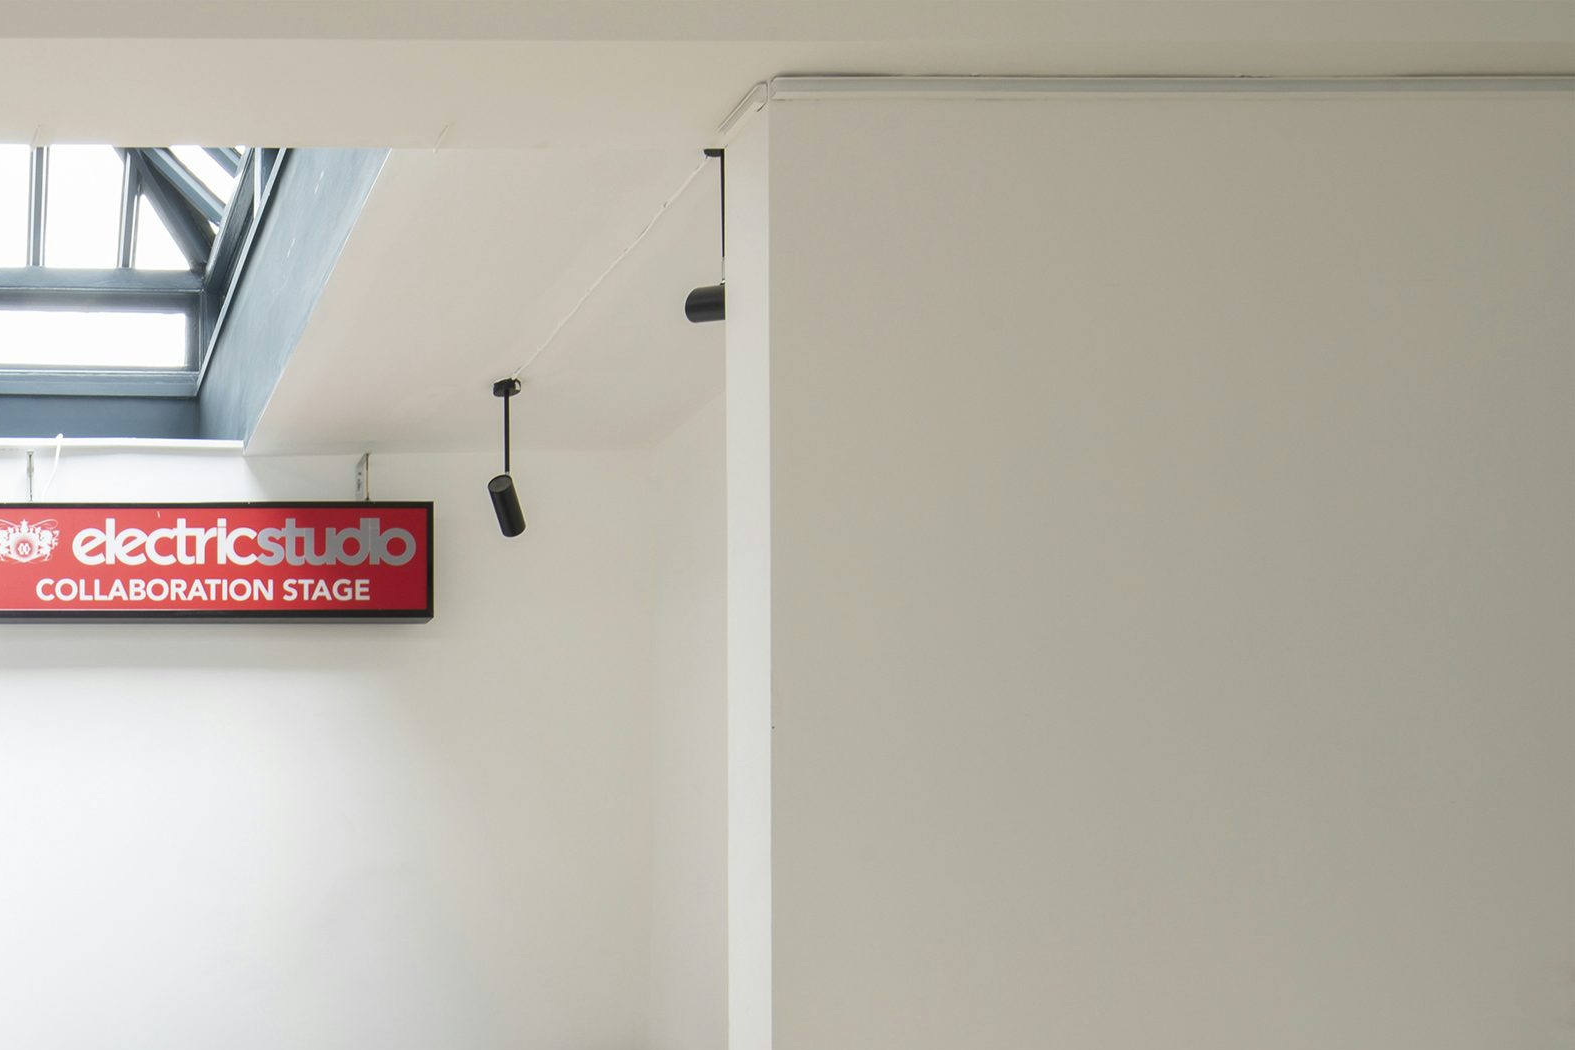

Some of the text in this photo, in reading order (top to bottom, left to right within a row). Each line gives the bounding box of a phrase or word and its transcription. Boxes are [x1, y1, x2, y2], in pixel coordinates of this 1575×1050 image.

[72, 517, 417, 566] electricstudio
[36, 578, 371, 601] COLLABORATION STAGE
